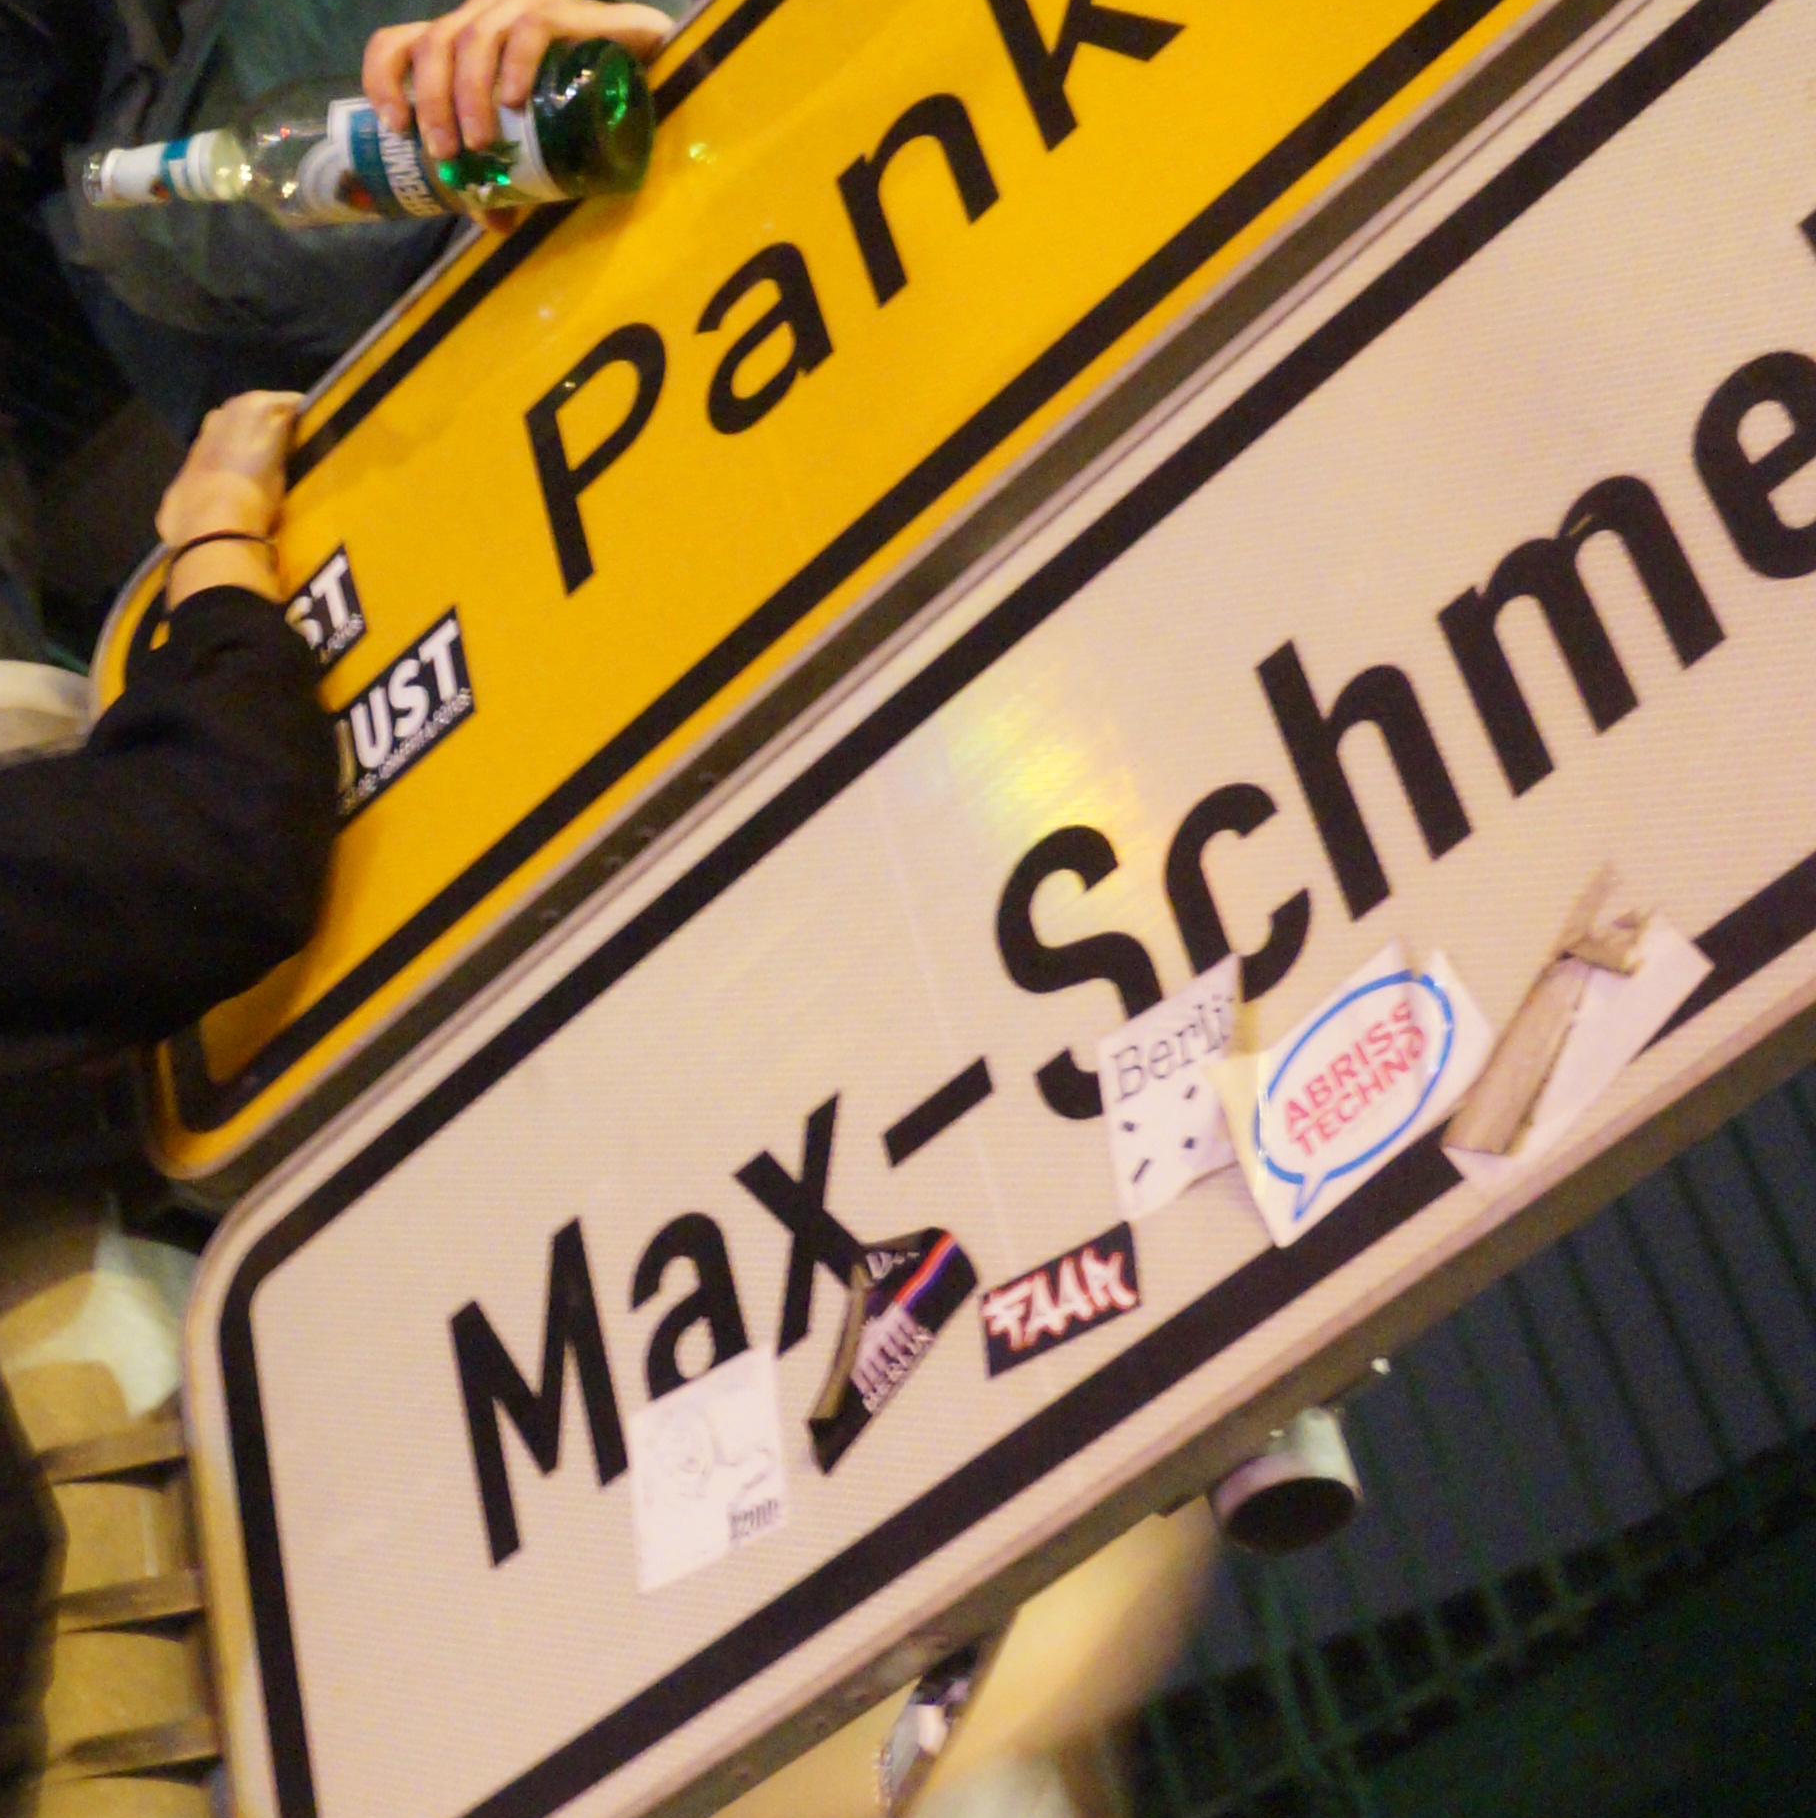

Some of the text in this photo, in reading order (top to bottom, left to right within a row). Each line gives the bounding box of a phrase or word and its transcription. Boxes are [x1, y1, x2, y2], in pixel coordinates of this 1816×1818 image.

[336, 618, 461, 795] JUST
[451, 221, 1816, 1565] Max-Schme
[1111, 993, 1234, 1103] Berli
[1285, 999, 1413, 1132] ABRISS
[1294, 1025, 1426, 1157] TECHNO
